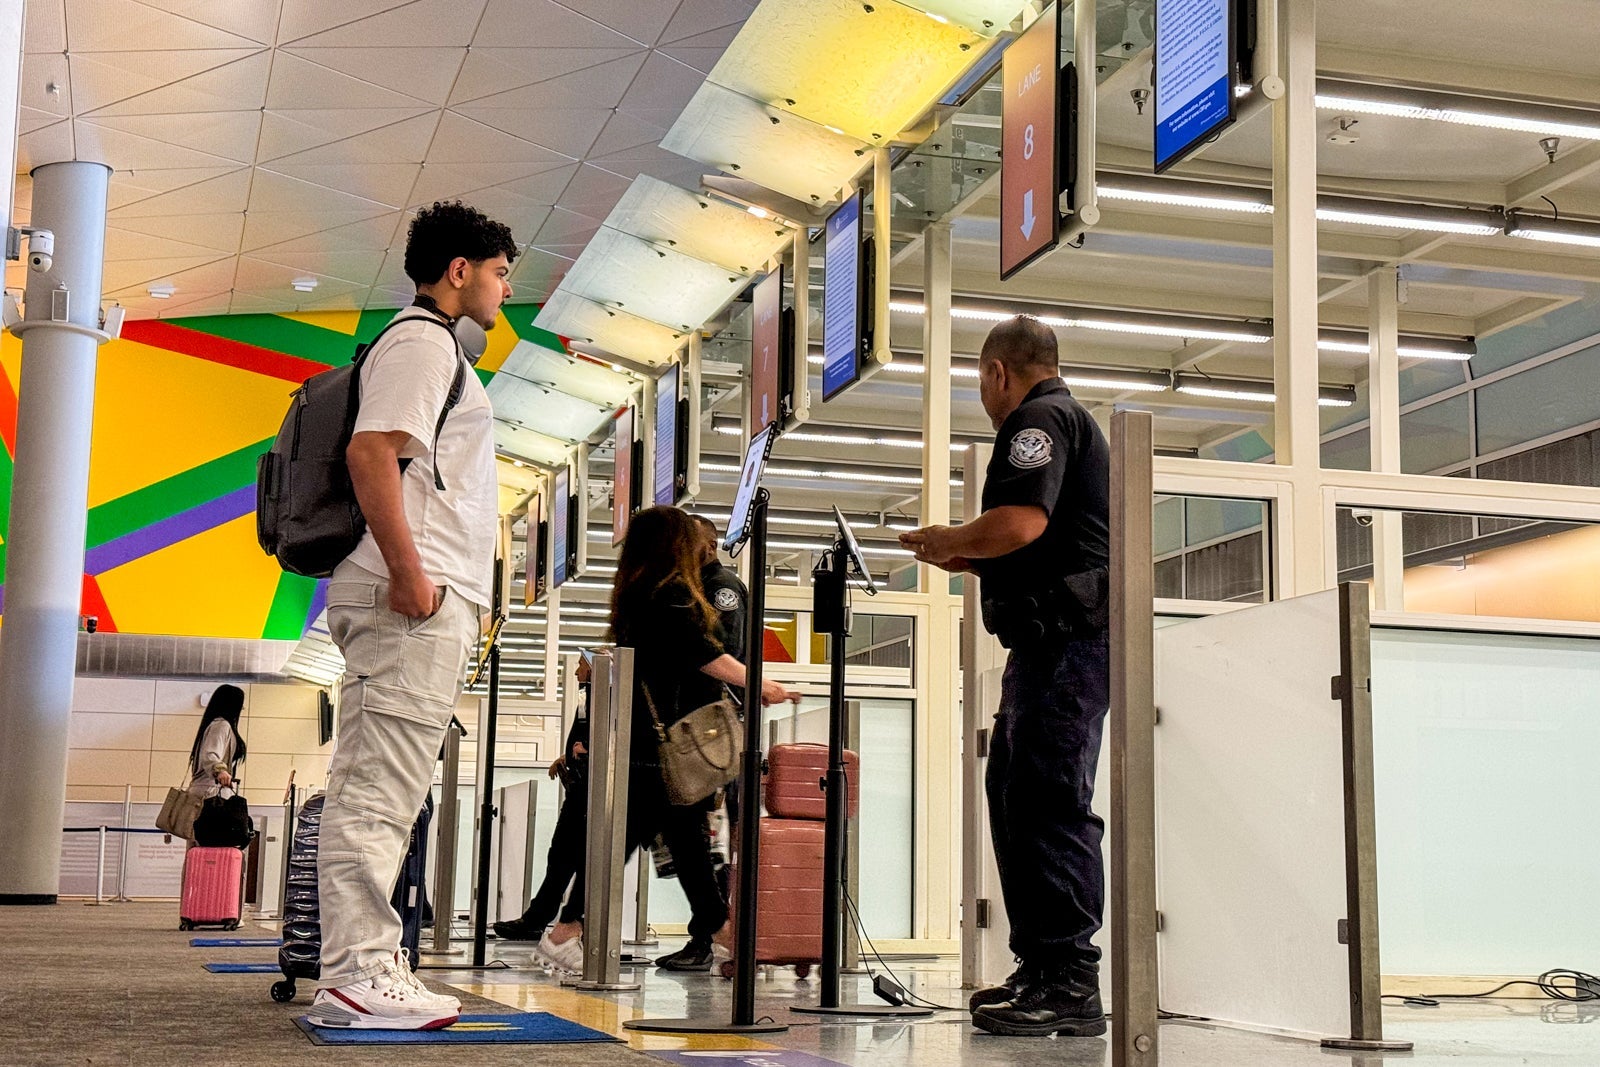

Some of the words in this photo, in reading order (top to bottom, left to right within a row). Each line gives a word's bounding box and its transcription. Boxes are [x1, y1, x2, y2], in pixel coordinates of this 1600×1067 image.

[1017, 63, 1041, 97] LANE
[1023, 123, 1034, 160] 8
[762, 345, 769, 372] 7
